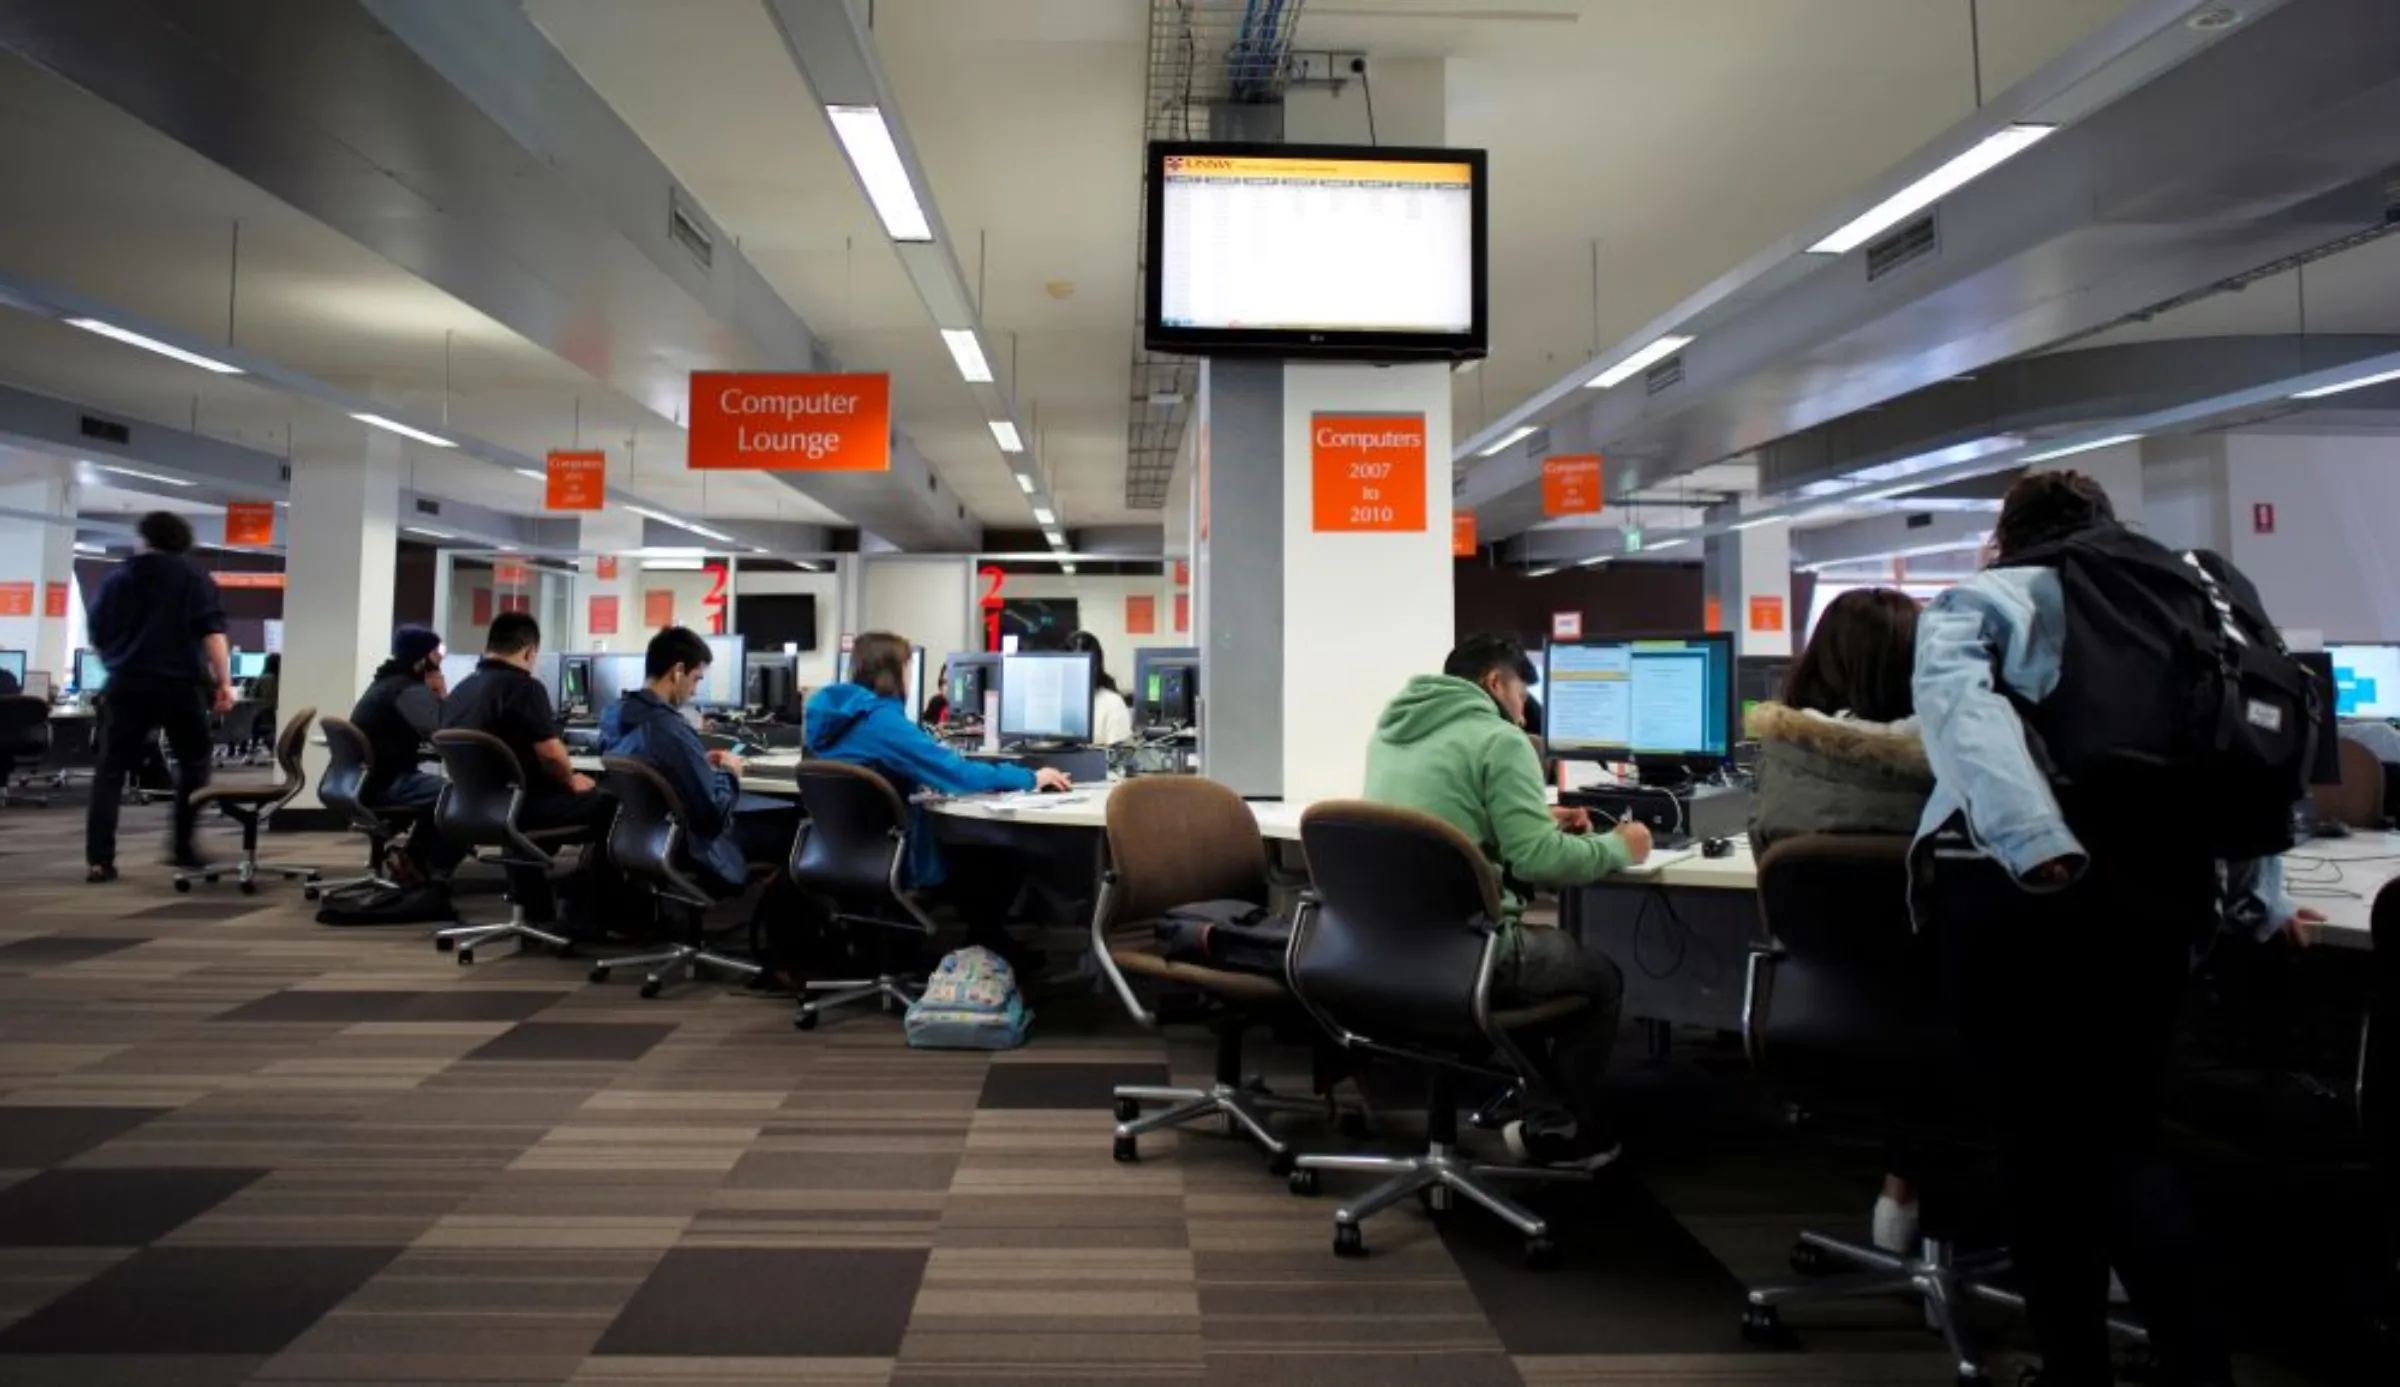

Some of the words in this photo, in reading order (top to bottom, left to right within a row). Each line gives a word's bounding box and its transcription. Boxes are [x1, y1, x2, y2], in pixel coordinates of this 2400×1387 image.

[720, 387, 859, 421] Computer
[737, 426, 840, 460] Lounge
[1316, 427, 1421, 454] Computers
[1349, 462, 1392, 479] 2007
[1362, 485, 1380, 500] to
[1350, 505, 1394, 523] 2010
